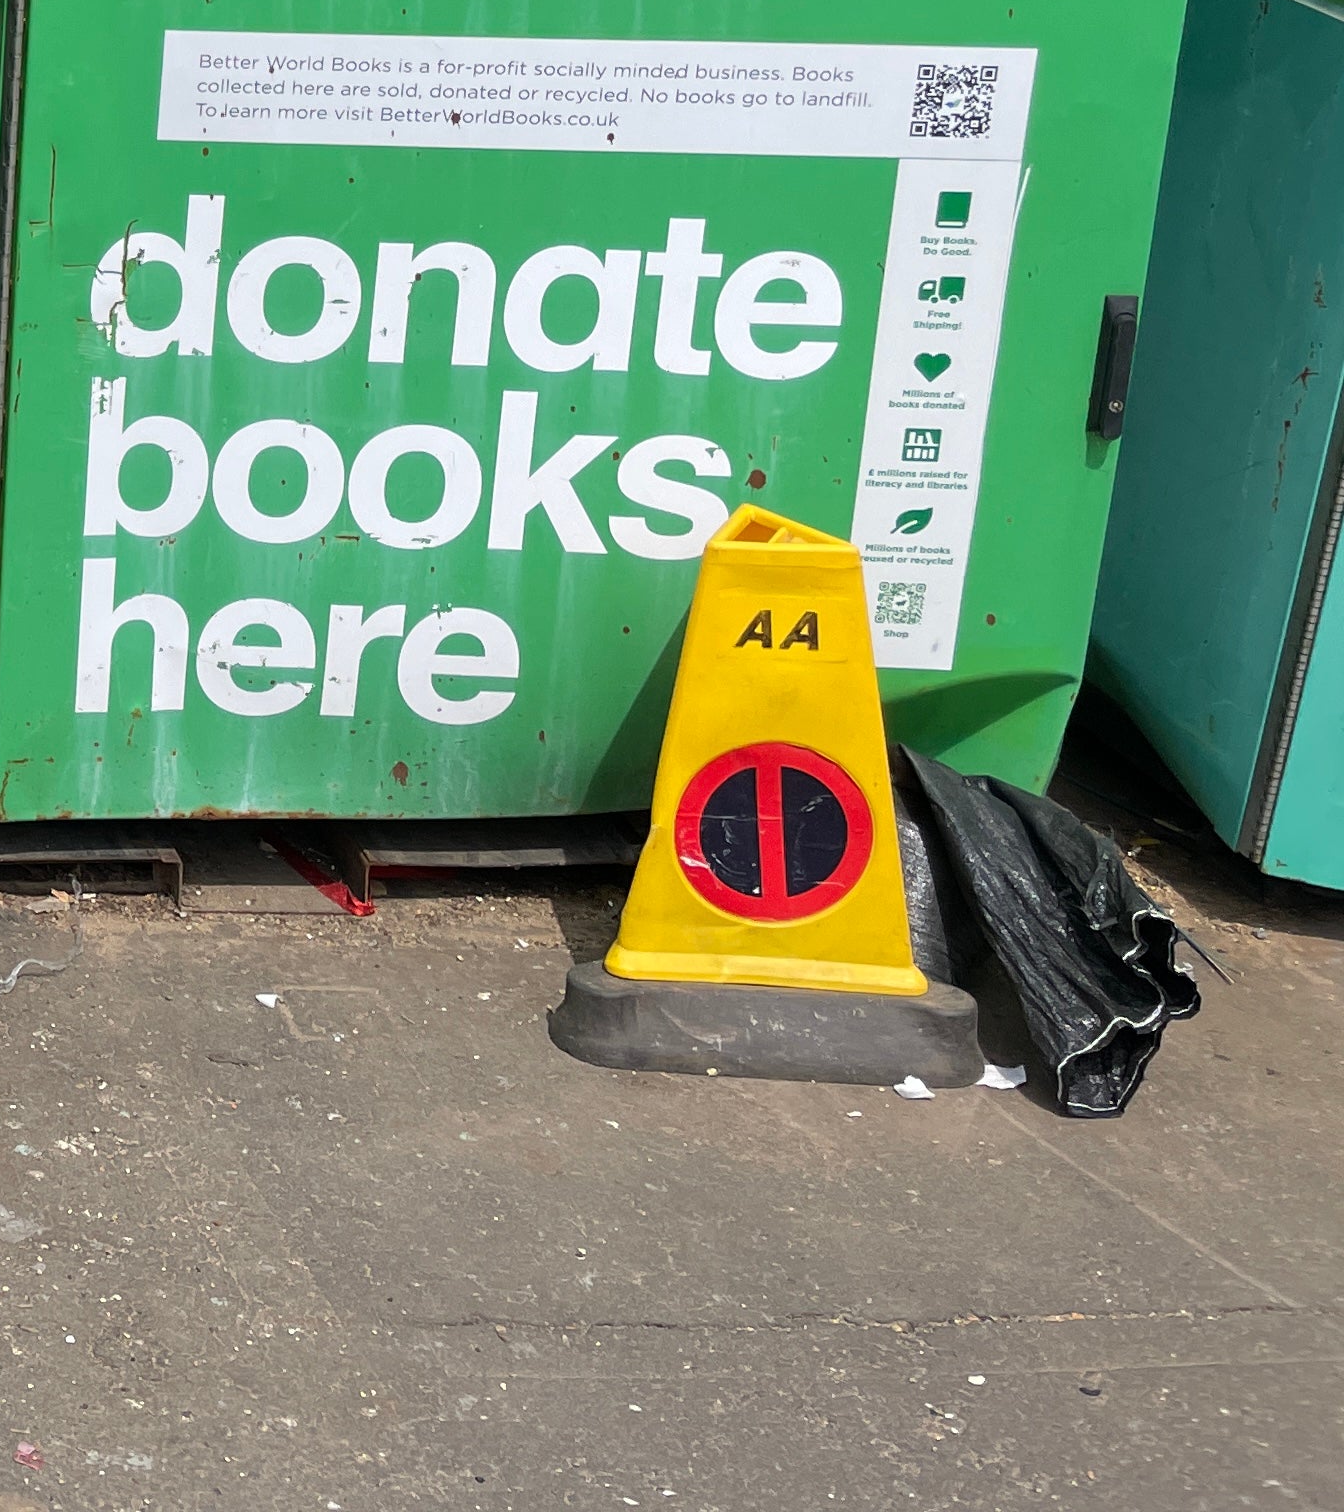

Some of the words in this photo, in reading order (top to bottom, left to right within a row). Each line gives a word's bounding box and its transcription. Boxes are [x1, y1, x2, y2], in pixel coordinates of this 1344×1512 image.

[199, 54, 259, 70] Better
[266, 55, 324, 72] World
[331, 57, 391, 73] Books
[398, 58, 412, 73] is
[419, 62, 430, 74] a
[437, 59, 527, 76] for-profit
[534, 61, 607, 80] socially
[613, 64, 688, 80] minded
[695, 65, 785, 81] business.
[792, 66, 854, 82] Books
[196, 103, 217, 118] To
[225, 104, 271, 119] learn
[278, 107, 328, 120] more
[335, 106, 373, 121] visit
[197, 80, 285, 95] collected
[292, 81, 335, 96] here
[340, 85, 371, 97] are
[377, 83, 422, 99] sold,
[429, 84, 511, 100] donated
[518, 89, 539, 101] or
[545, 88, 633, 105] recycled.
[641, 89, 668, 103] No
[675, 90, 735, 106] books
[742, 93, 768, 108] go
[775, 92, 795, 106] to
[802, 91, 873, 107] landfill.
[90, 194, 844, 381] donate
[83, 376, 733, 561] books
[74, 558, 521, 726] here
[735, 609, 819, 652] AA
